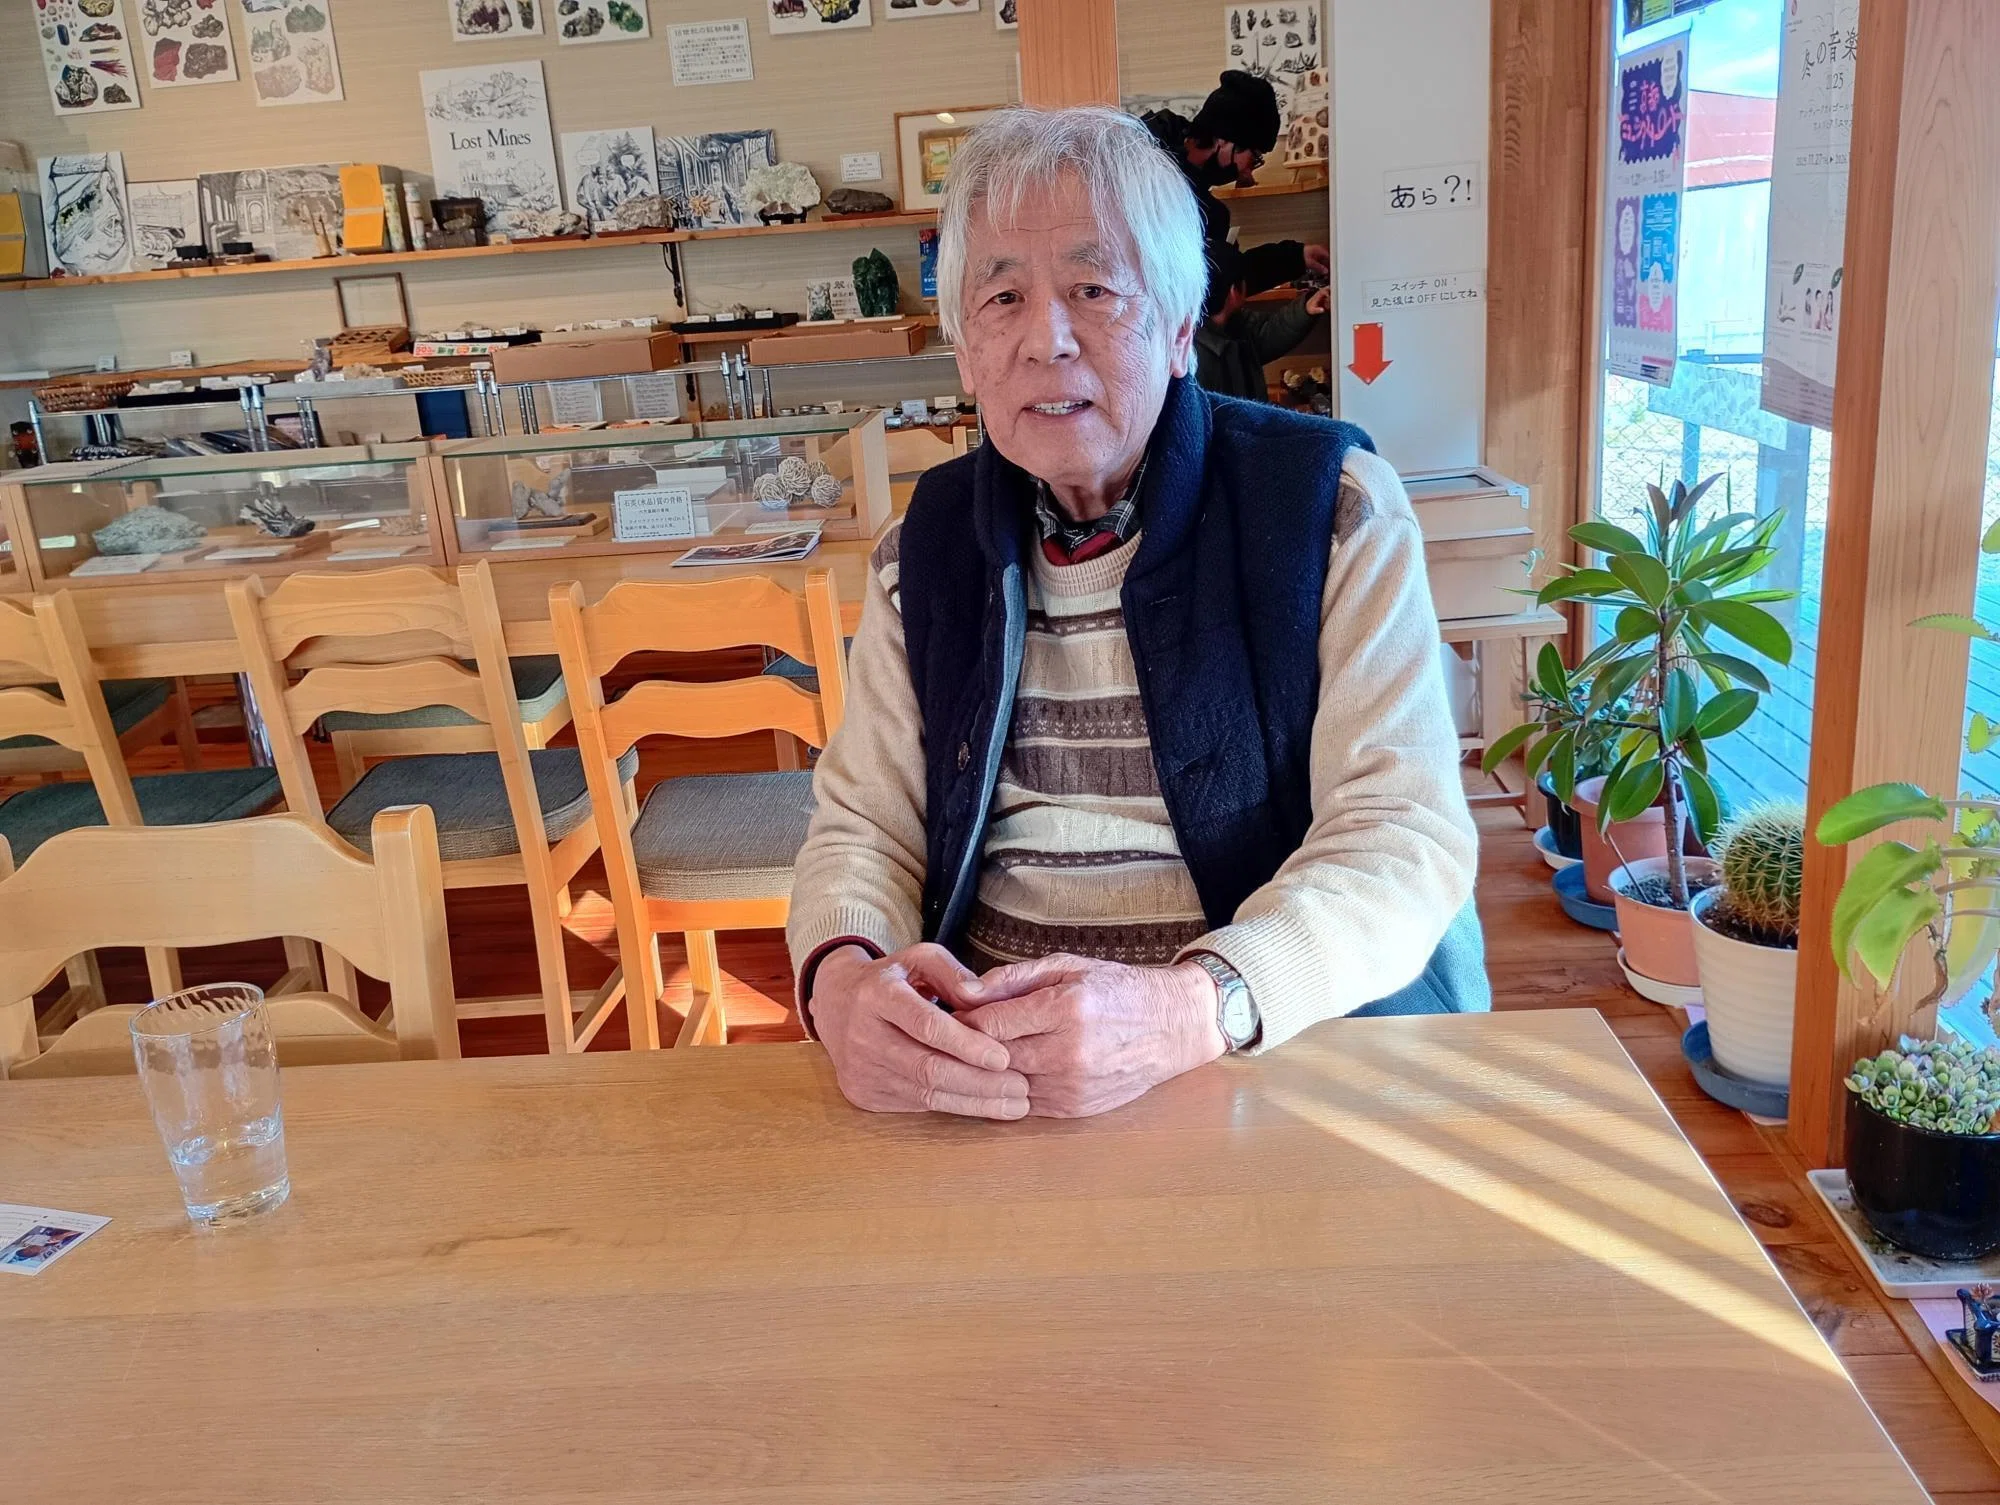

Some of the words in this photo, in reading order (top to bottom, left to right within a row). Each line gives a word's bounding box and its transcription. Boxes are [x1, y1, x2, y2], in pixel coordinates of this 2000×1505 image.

[449, 131, 482, 150] Lost
[487, 128, 532, 147] Mines
[1390, 280, 1428, 292] スイッチ
